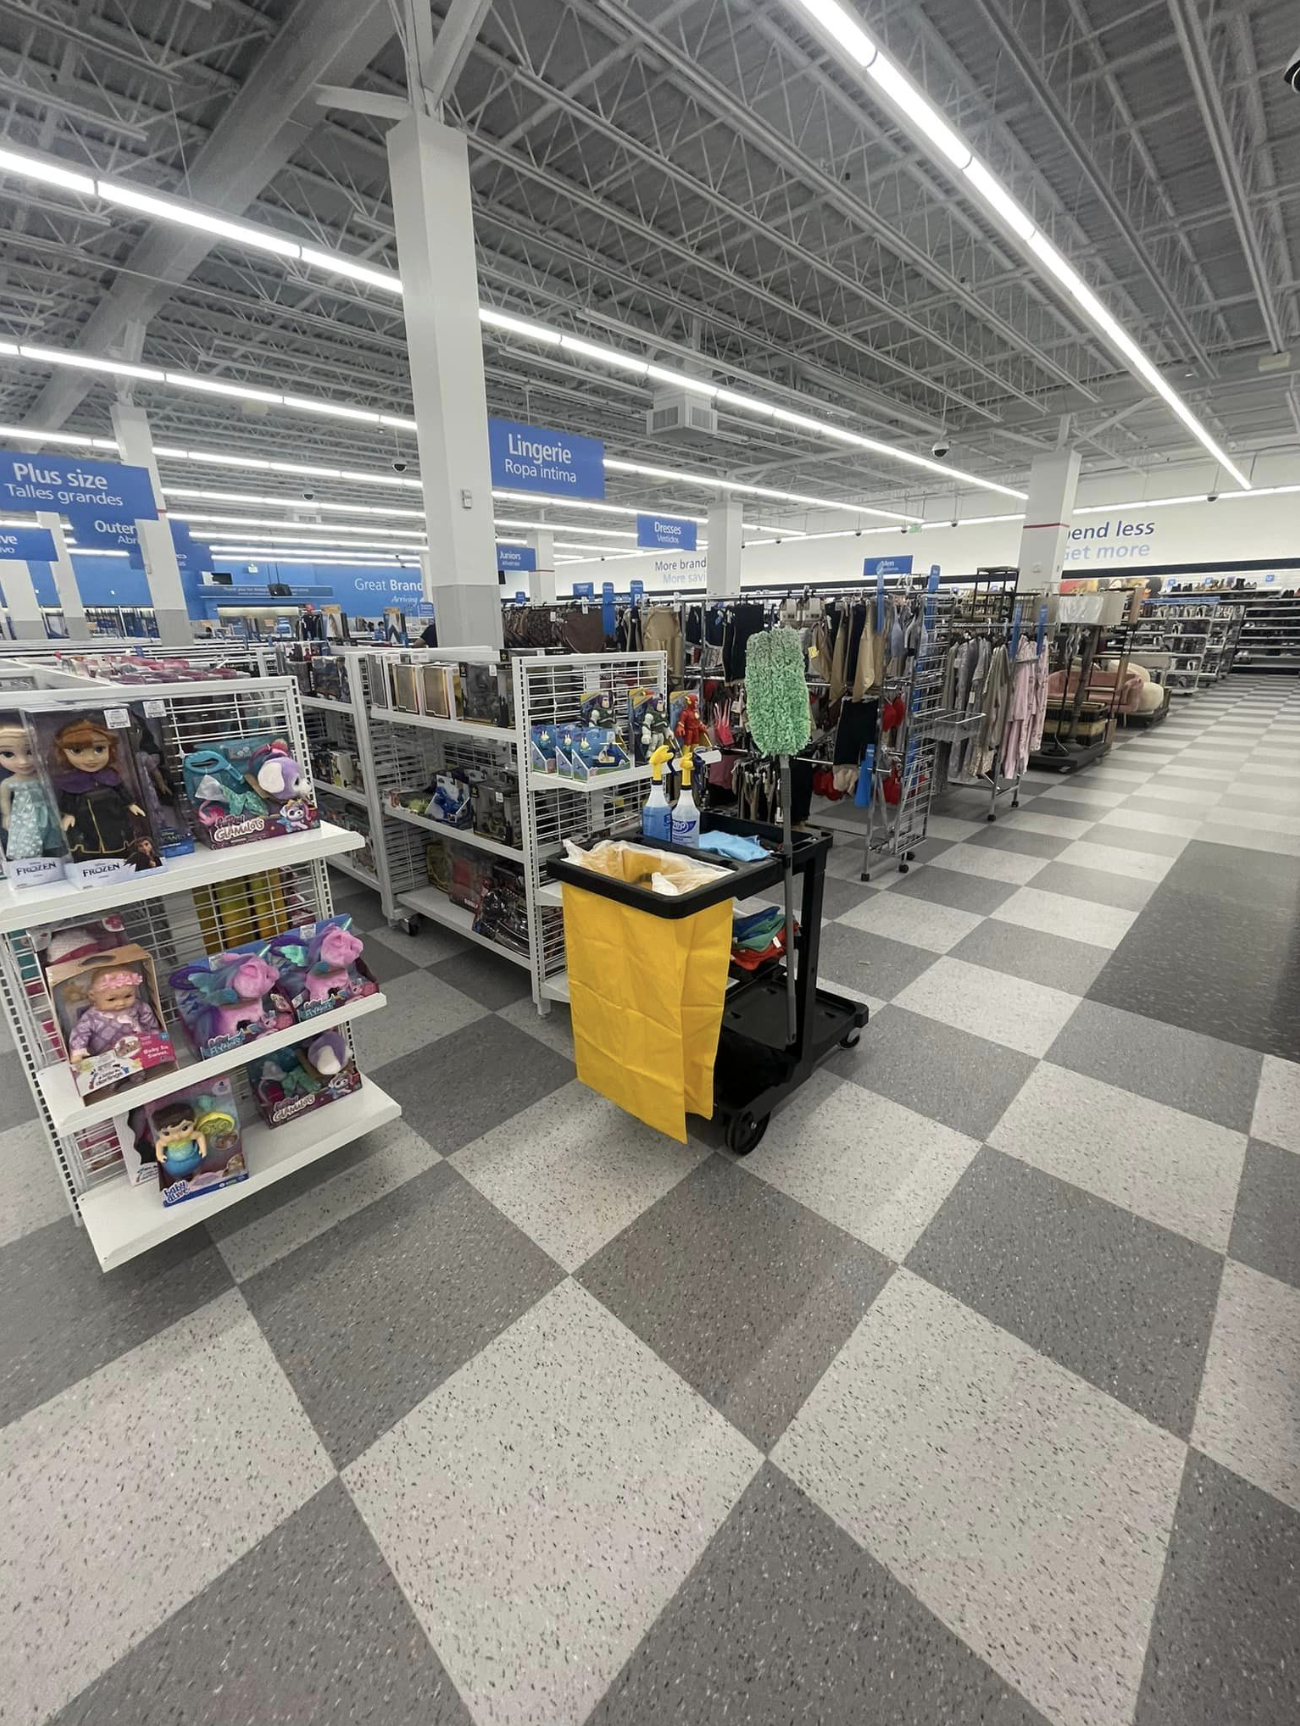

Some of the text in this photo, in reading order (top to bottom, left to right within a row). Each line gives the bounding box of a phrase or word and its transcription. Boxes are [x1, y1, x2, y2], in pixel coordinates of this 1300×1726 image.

[508, 433, 572, 465] Lingerie
[12, 462, 108, 489] Plus size
[504, 458, 577, 483] Ropa intima
[4, 483, 123, 506] Talles grandes
[94, 520, 137, 535] Outer
[654, 521, 681, 535] Dresses
[1066, 519, 1155, 541] end less
[0, 535, 18, 545] ve
[499, 550, 521, 561] Juniors
[1096, 543, 1151, 560] more
[655, 556, 707, 572] More brand
[354, 577, 387, 591] Great
[663, 574, 686, 584] More
[15, 861, 57, 876] FROZEN
[82, 862, 120, 878] FROZEN
[163, 1181, 187, 1196] baby
